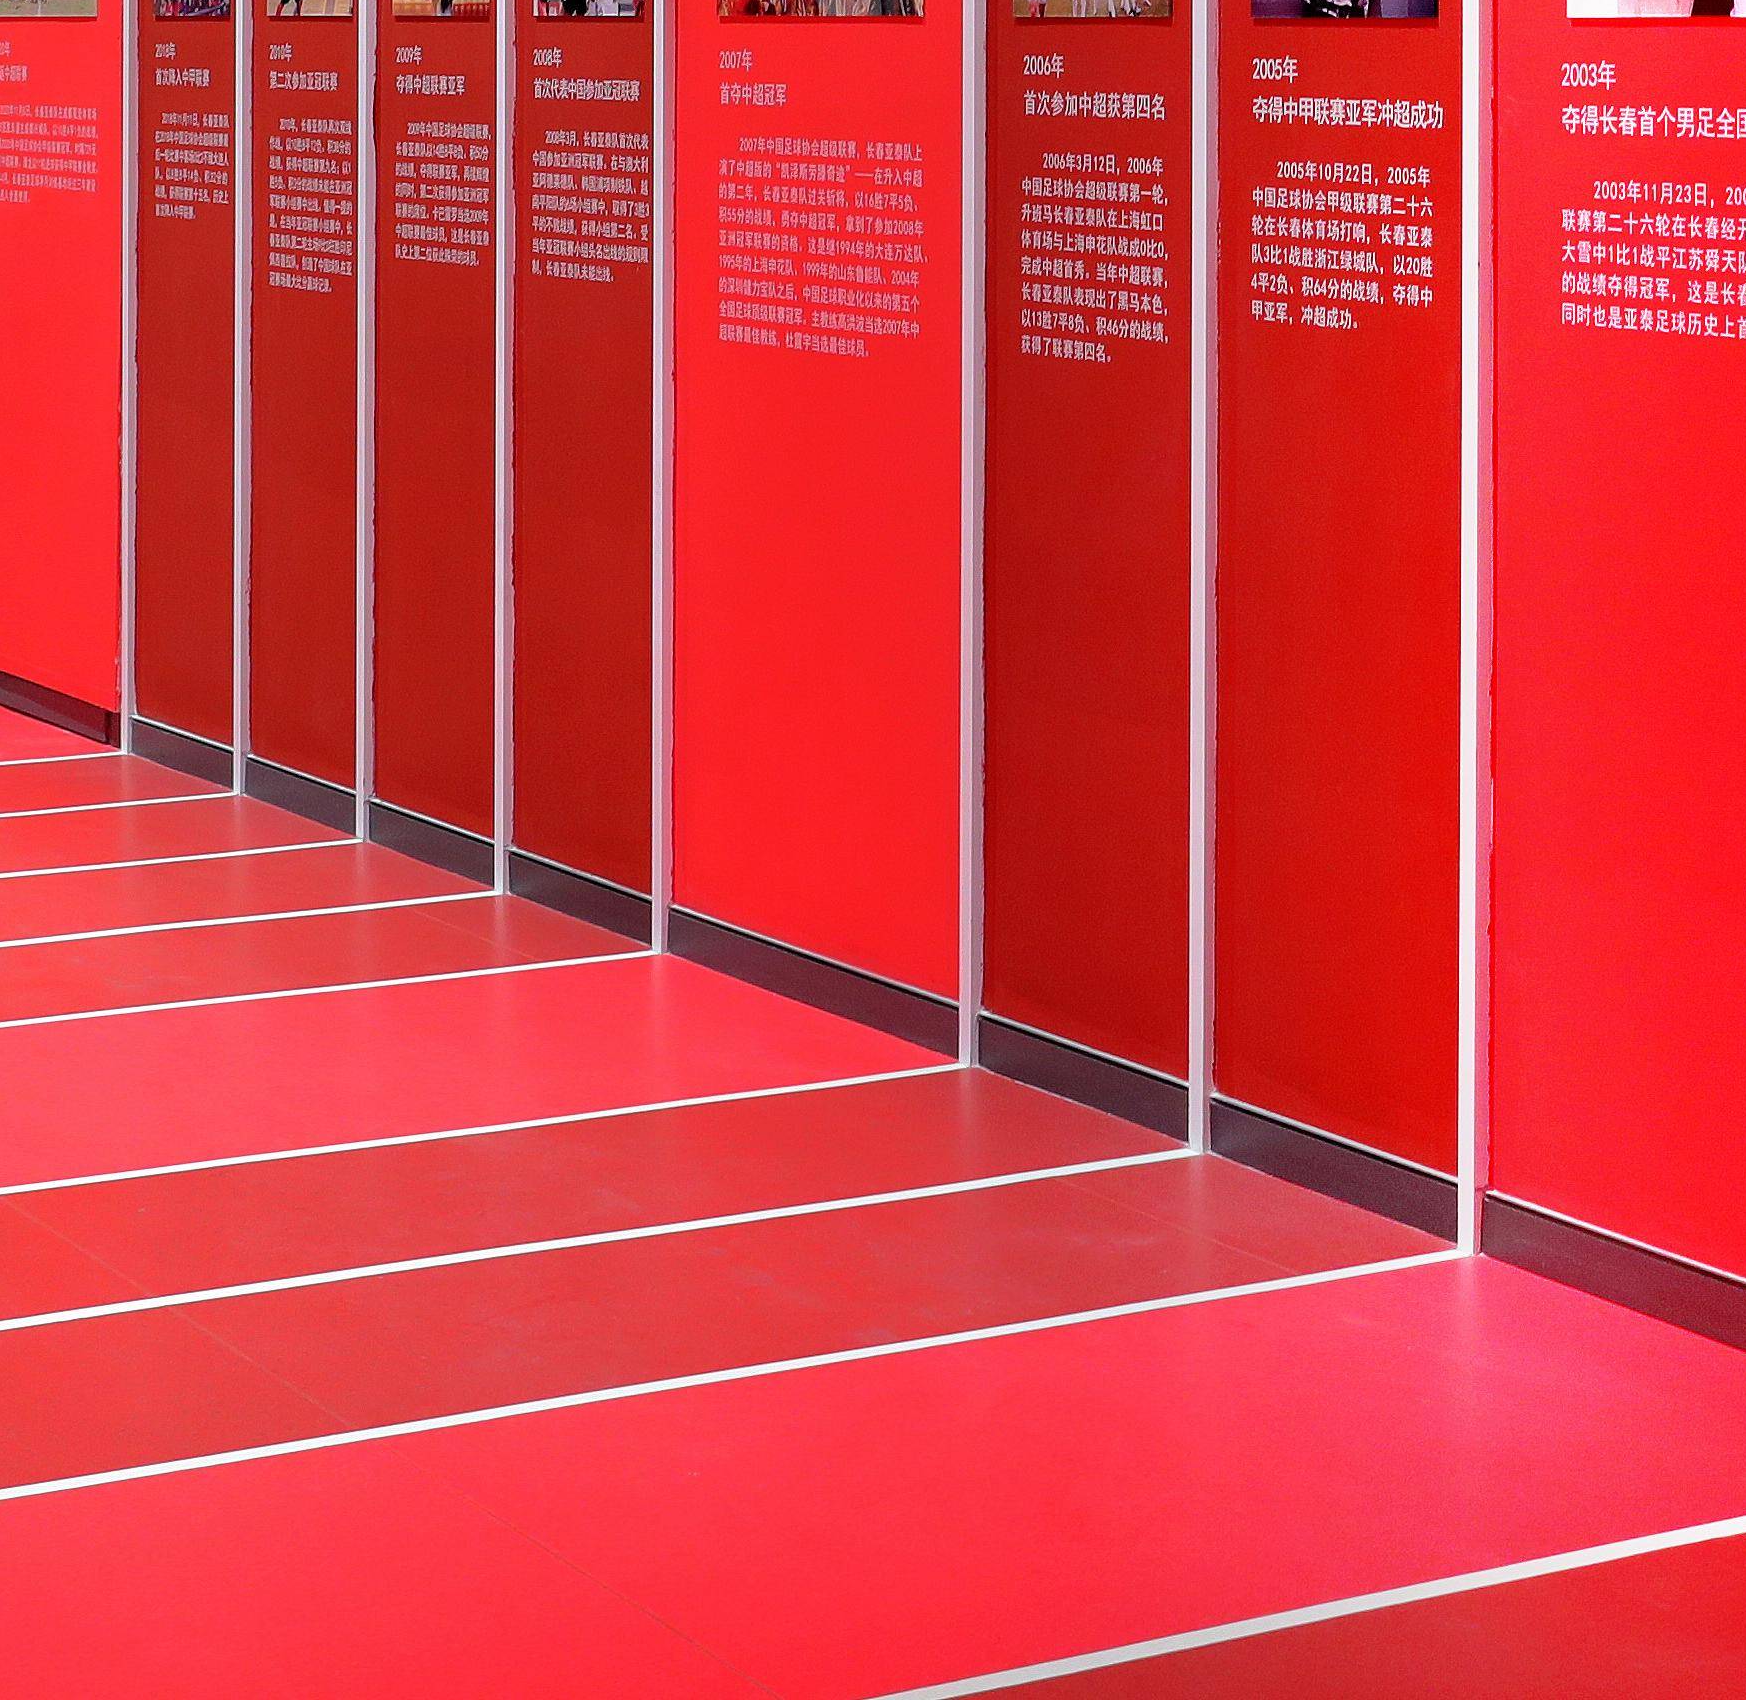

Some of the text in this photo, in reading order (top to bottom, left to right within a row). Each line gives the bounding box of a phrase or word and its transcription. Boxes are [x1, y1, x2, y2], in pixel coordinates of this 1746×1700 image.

[1023, 53, 1065, 79] 2006年
[1252, 55, 1299, 84] 2005年
[1561, 60, 1616, 91] 2003年
[720, 82, 787, 107] 首夺中超冠军
[1023, 89, 1166, 121] 首次参加中超获第四名
[1252, 96, 1444, 130] 夺得中甲联赛亚军冲超成功
[1276, 160, 1431, 188] 2005年10月22日，2005年
[1252, 186, 1434, 217] 中国足球协会甲级联赛第二十六
